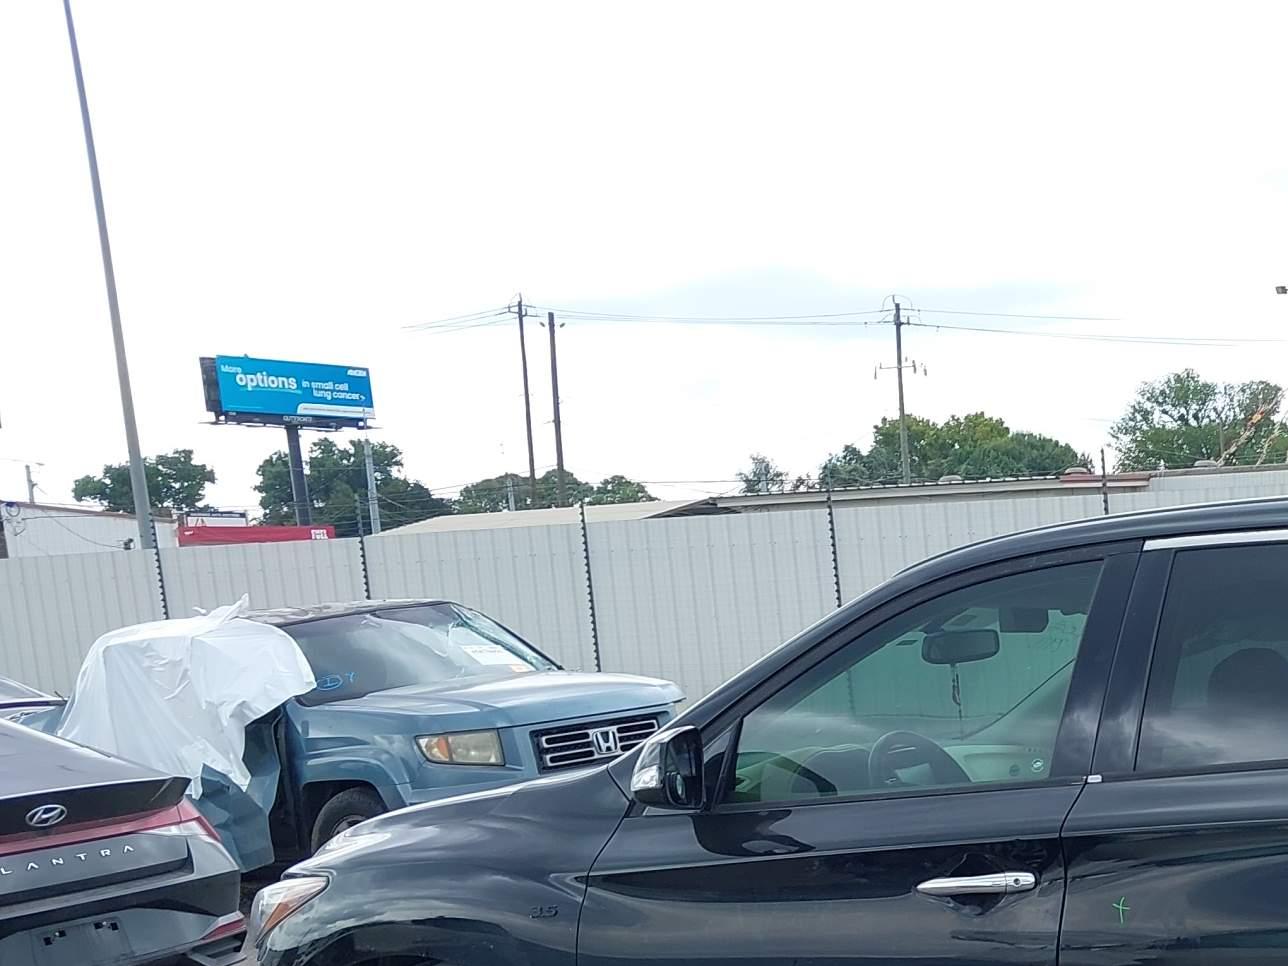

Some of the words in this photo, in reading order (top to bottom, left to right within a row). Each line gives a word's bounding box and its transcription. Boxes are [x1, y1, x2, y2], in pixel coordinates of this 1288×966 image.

[235, 371, 298, 391] options
[311, 382, 333, 390] small
[313, 388, 331, 400] lung
[311, 529, 328, 540] FUEL
[0, 845, 135, 875] LANTRA
